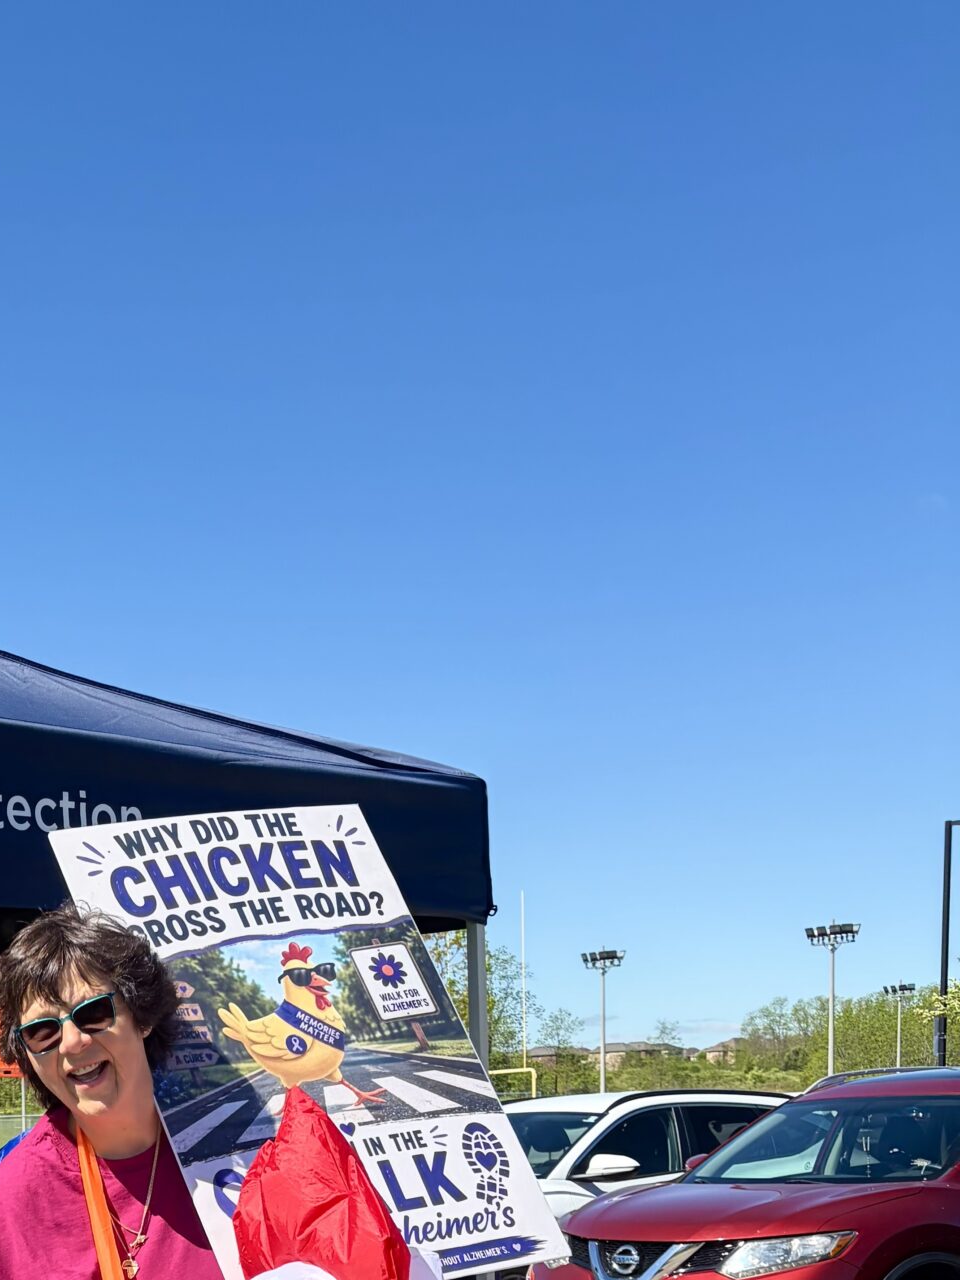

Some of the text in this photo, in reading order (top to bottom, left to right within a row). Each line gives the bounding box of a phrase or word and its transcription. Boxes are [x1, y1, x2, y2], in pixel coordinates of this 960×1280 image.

[113, 812, 302, 859] WHY DID THE
[110, 840, 360, 917] CHICKEN
[230, 896, 290, 928] THE
[294, 890, 384, 920] ROAD?
[379, 988, 420, 1002] WALK FOR
[296, 1011, 340, 1040] MEMORIES
[299, 1022, 335, 1045] MATTER
[363, 1136, 386, 1157] IN
[388, 1129, 428, 1152] THE
[377, 1151, 468, 1213] LK
[397, 1203, 516, 1246] heimer's
[463, 1246, 510, 1262] ALZHEIMER'S.
